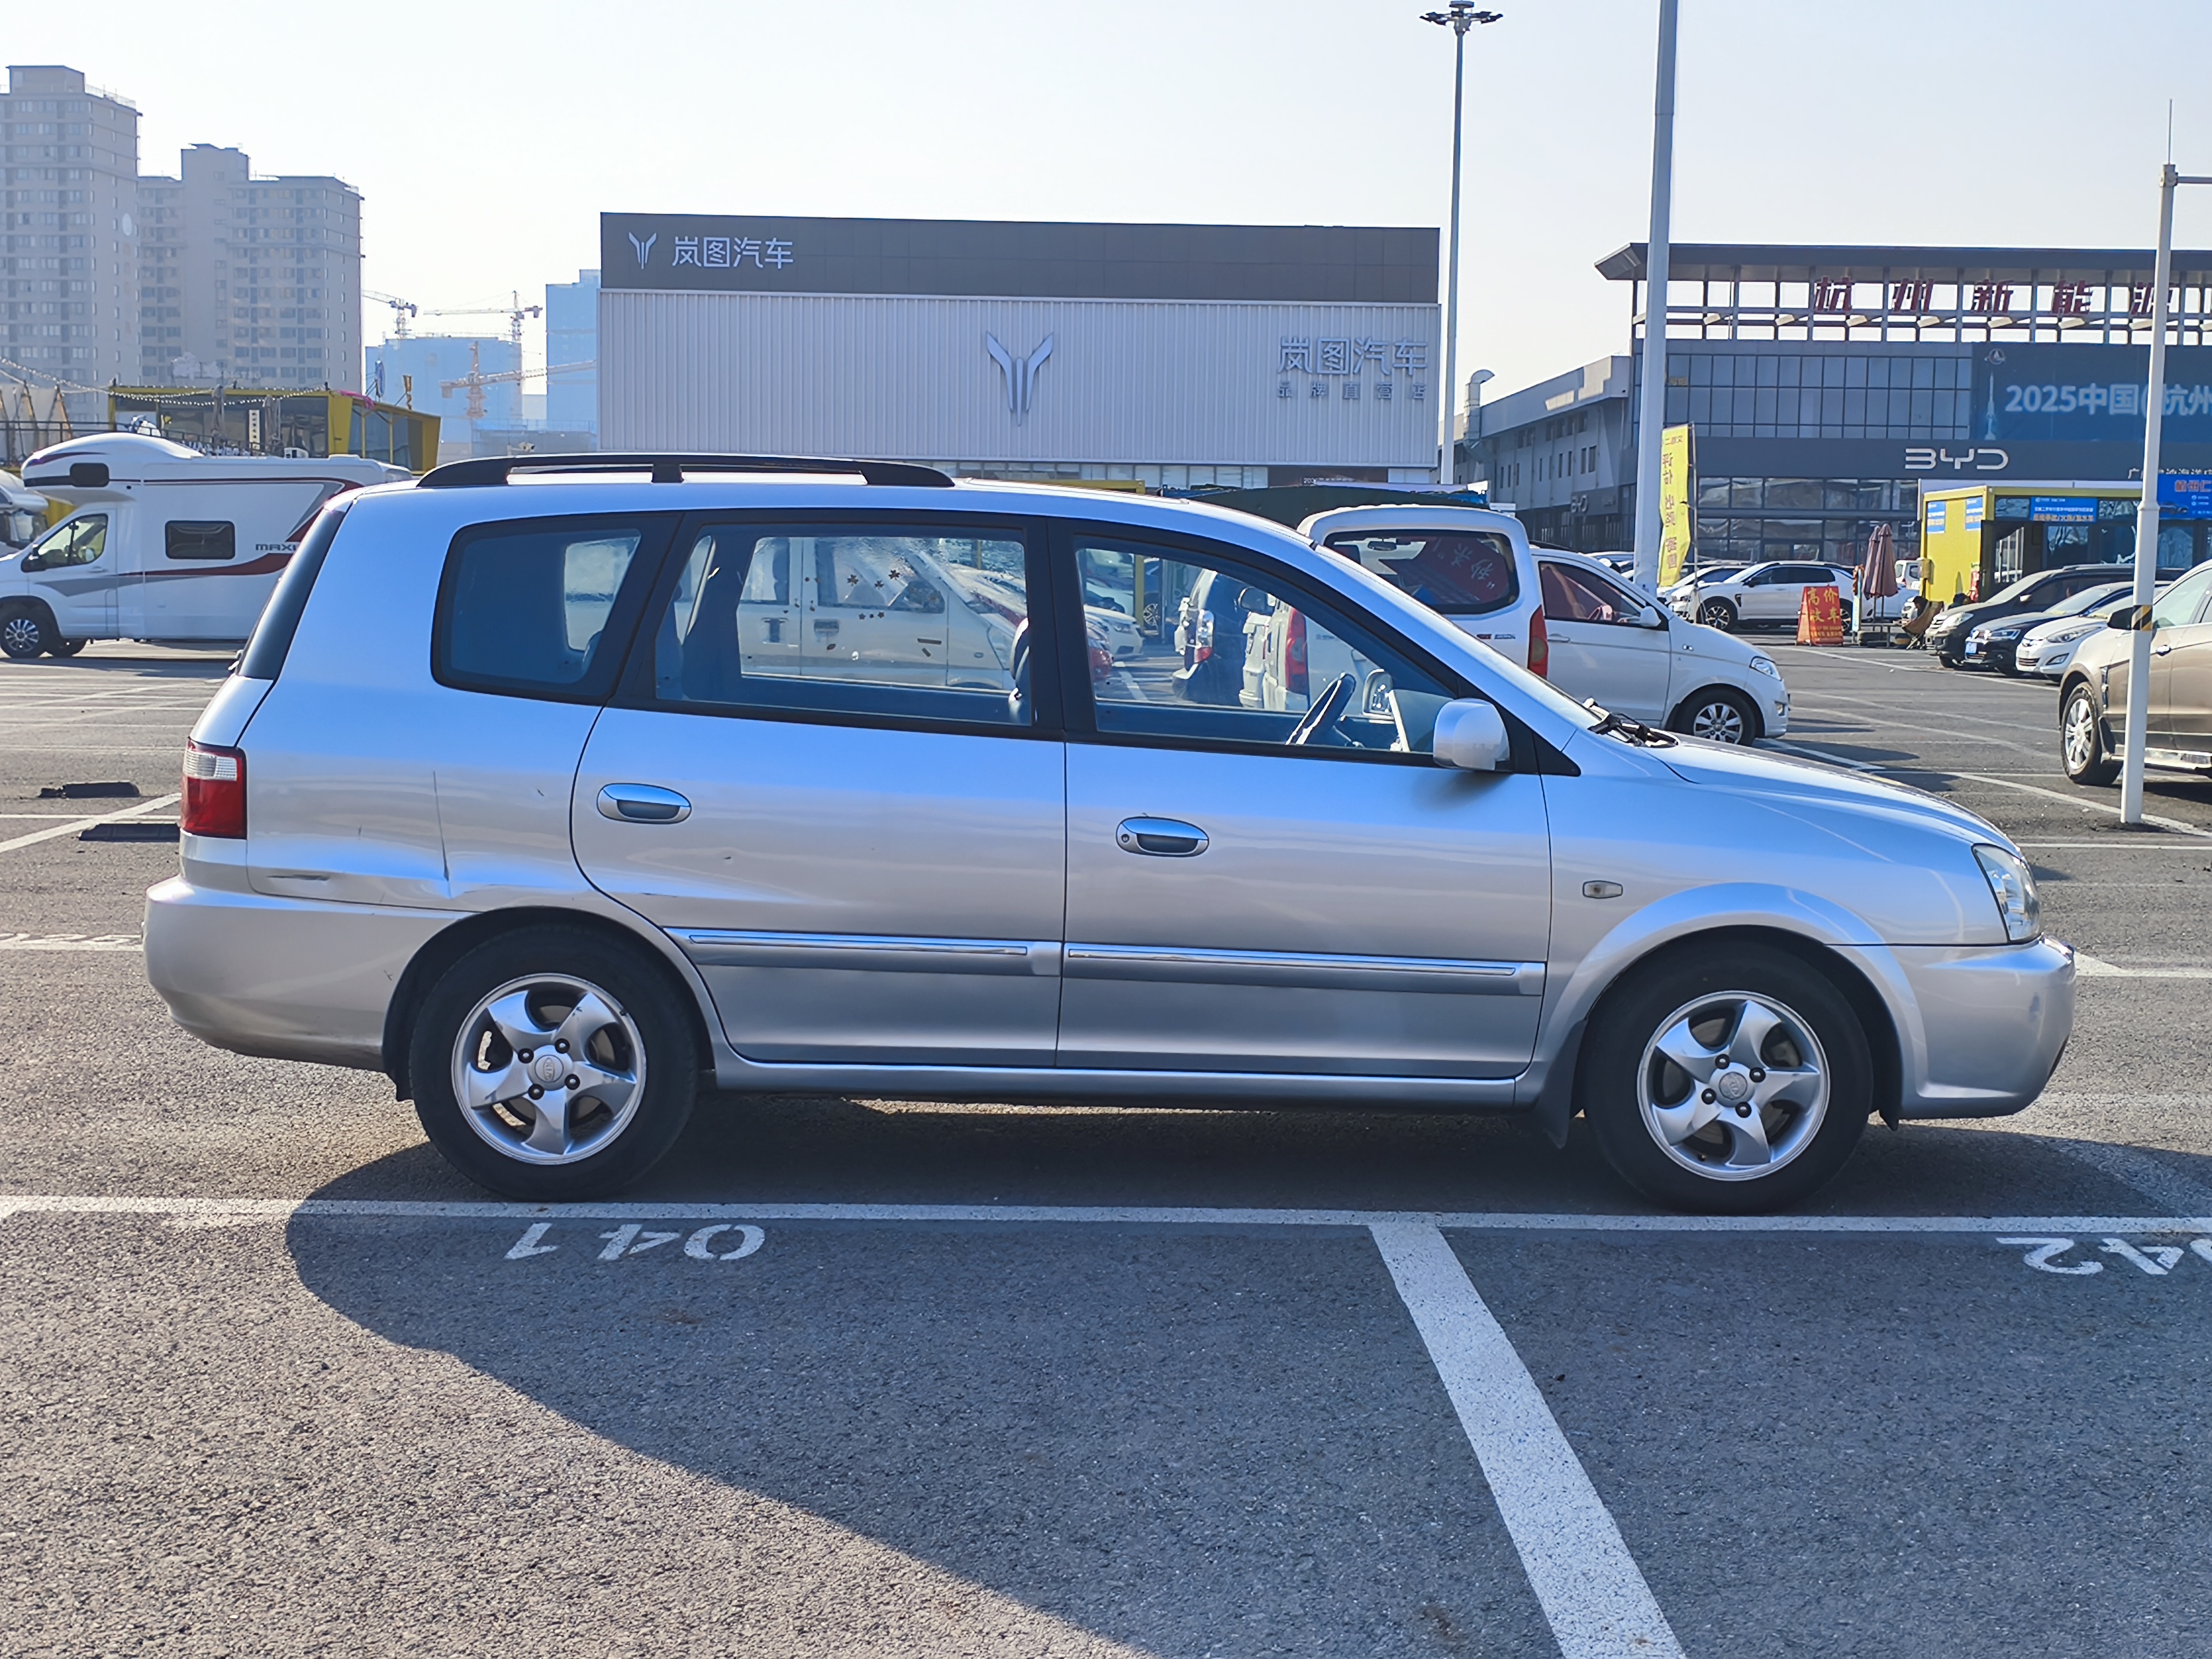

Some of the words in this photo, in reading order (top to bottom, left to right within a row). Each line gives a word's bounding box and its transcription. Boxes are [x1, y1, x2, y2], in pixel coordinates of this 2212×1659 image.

[672, 236, 794, 269] 岚图汽车
[1278, 337, 1428, 375] 岚图汽车
[1278, 382, 1426, 400] 品牌直营店
[1905, 448, 2008, 469] BYD
